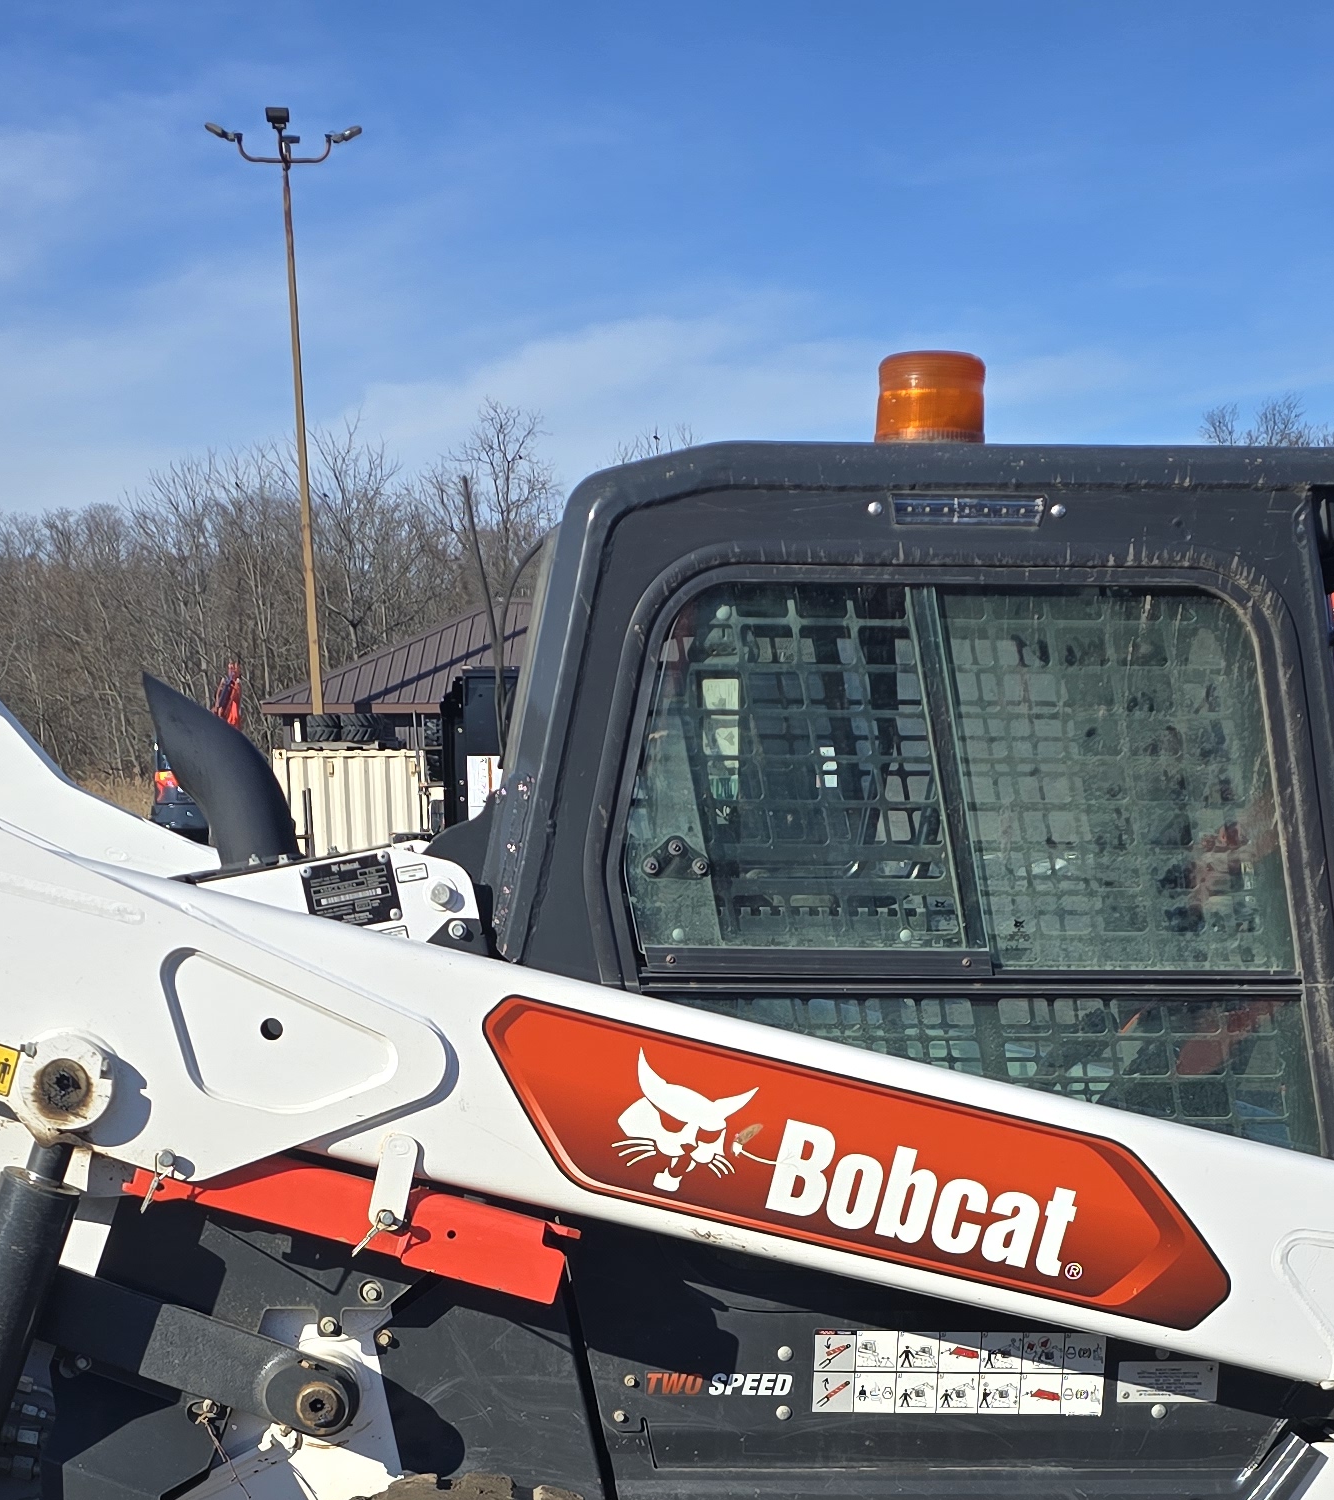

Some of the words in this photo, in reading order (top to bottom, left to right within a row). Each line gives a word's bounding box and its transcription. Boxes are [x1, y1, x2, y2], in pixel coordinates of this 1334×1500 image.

[765, 1118, 1078, 1278] Bobcat
[646, 1373, 703, 1395] TWO
[708, 1372, 794, 1396] SPEED
